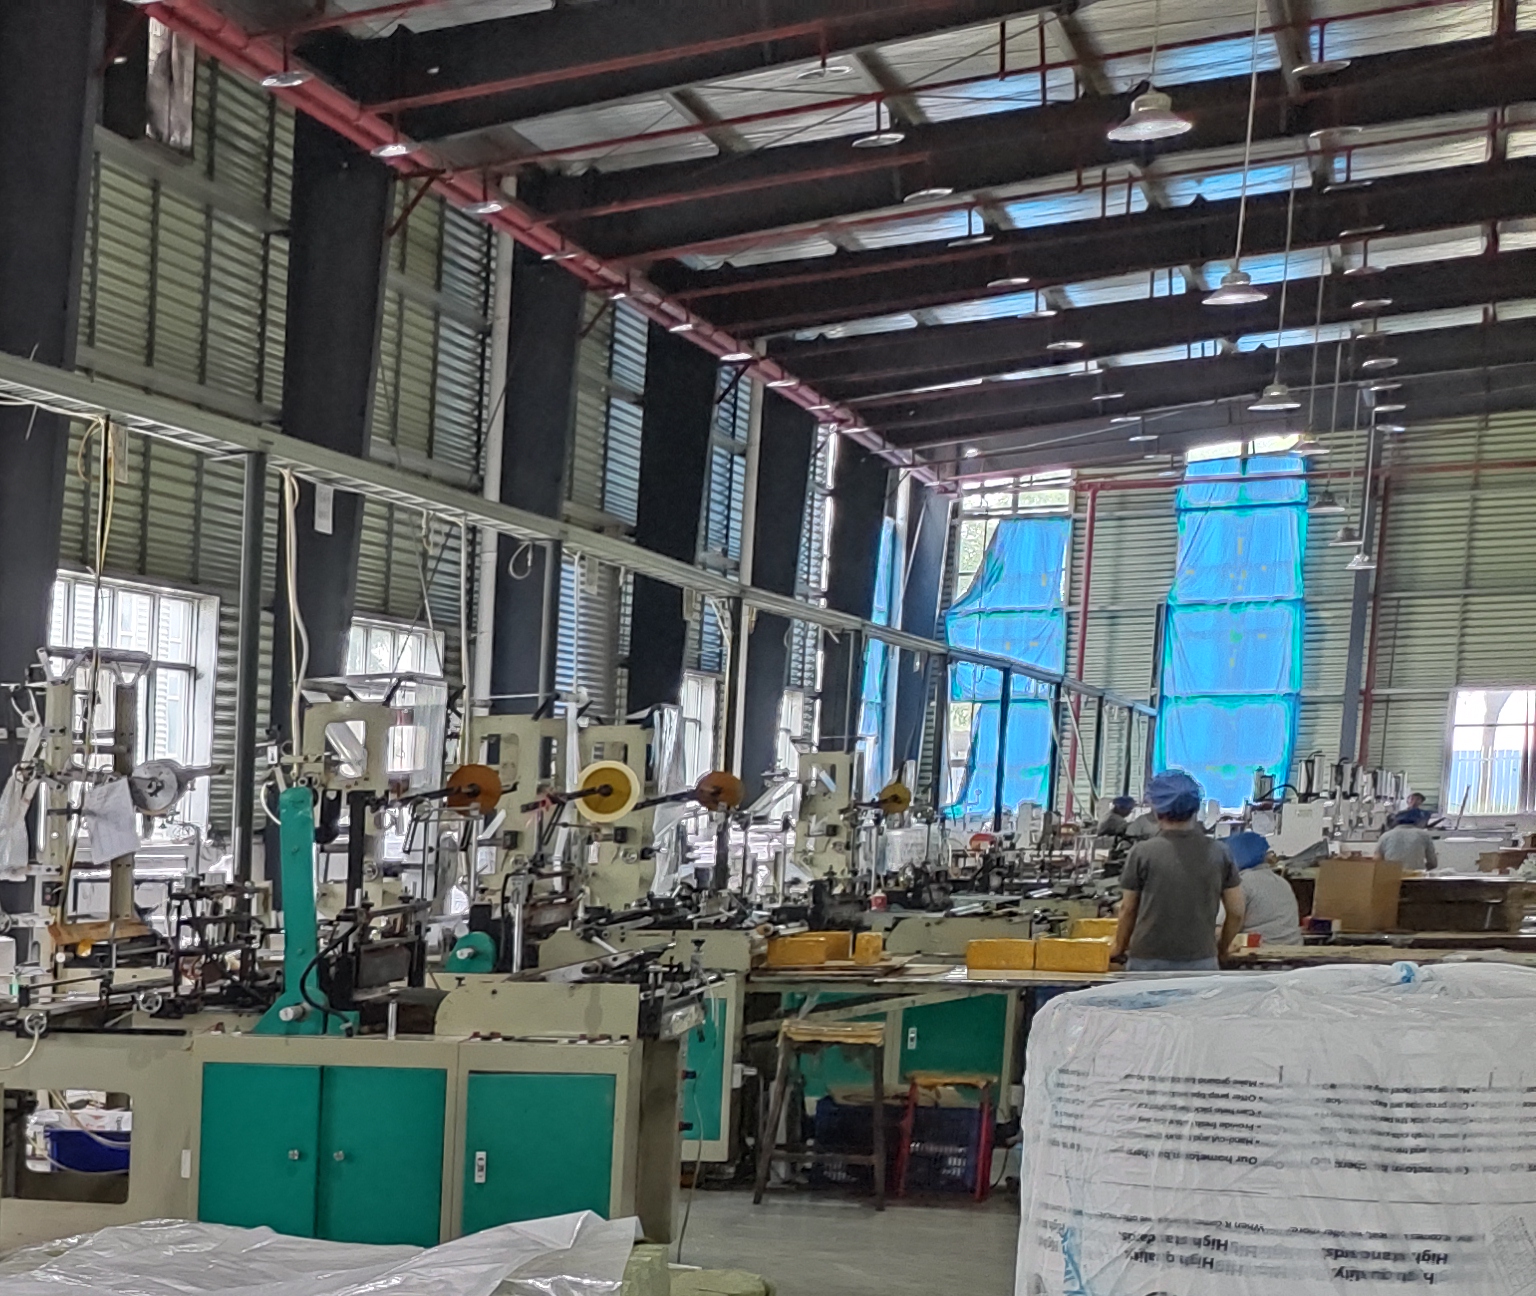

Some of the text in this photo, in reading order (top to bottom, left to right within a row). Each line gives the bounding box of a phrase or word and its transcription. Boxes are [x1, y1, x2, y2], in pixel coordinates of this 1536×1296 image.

[1236, 1154, 1258, 1165] Our
[1192, 1235, 1228, 1250] High
[1180, 1252, 1214, 1270] High
